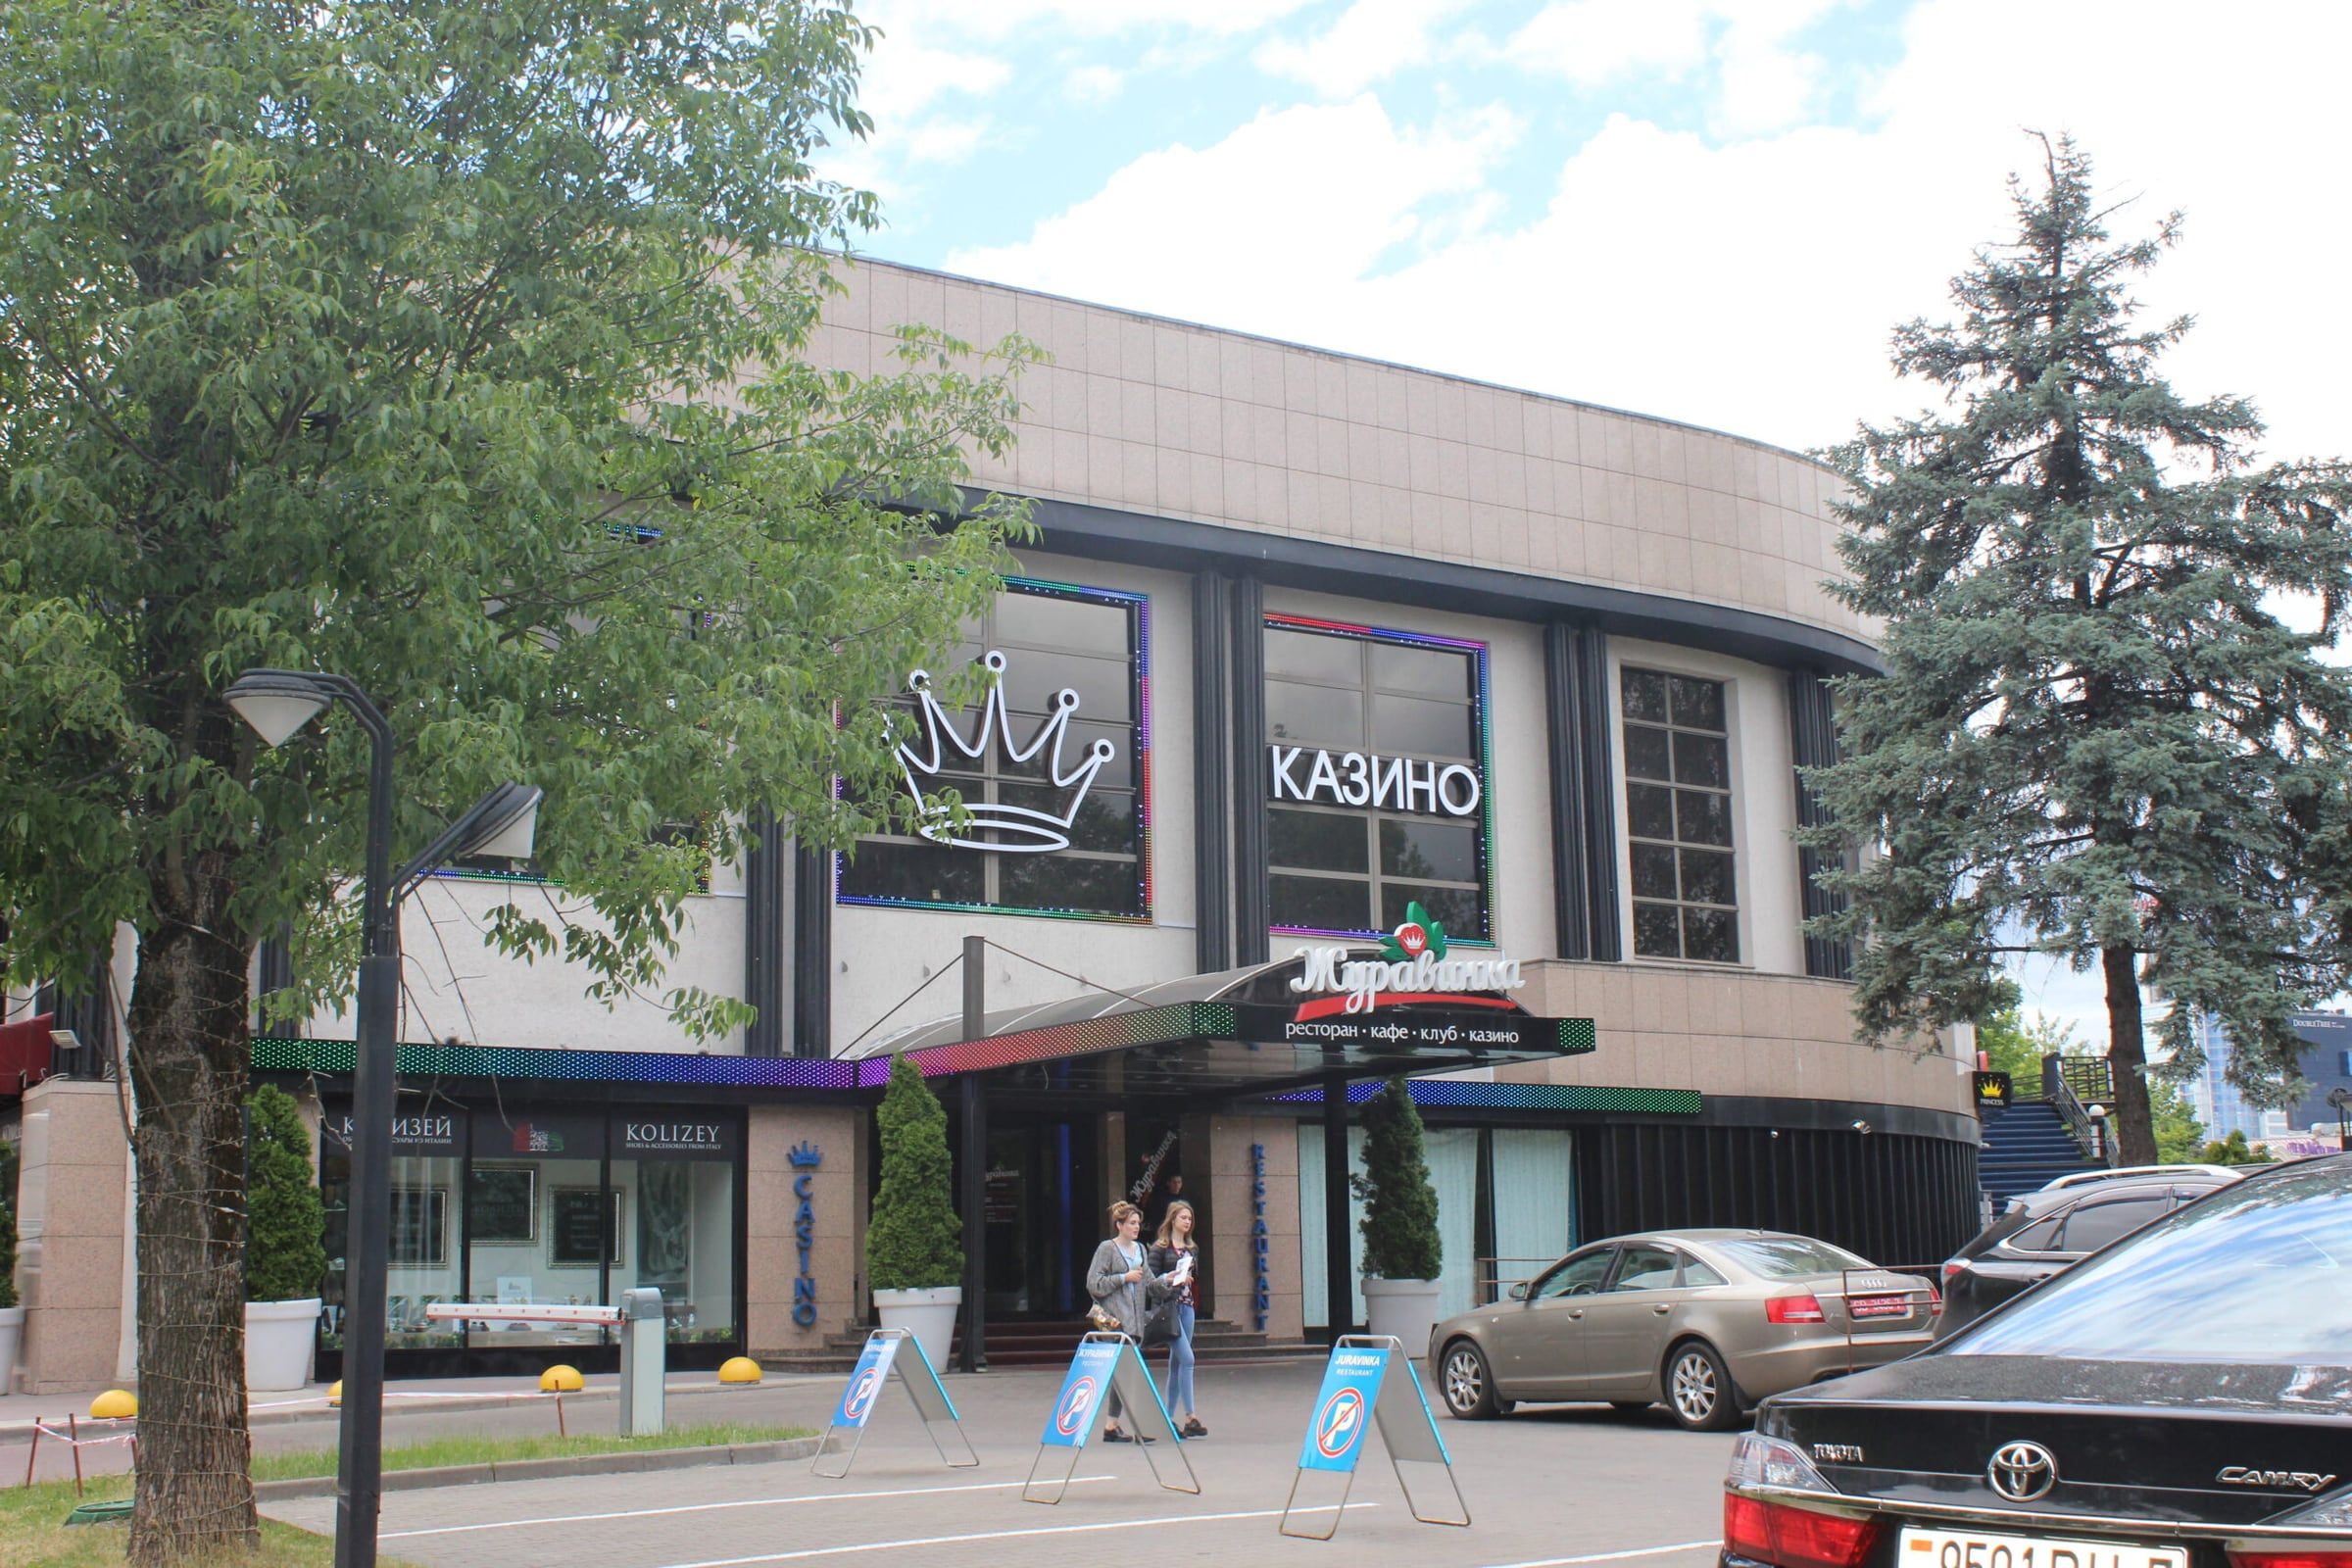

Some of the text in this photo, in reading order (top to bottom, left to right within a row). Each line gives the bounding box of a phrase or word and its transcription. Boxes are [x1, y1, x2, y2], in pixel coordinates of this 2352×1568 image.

[1272, 745, 1480, 816] КАЗИНО
[1290, 946, 1526, 1014] Журавинка
[1286, 1022, 1519, 1044] ресторан кафе клуб казино
[343, 1115, 452, 1137] КИЗЕЙ
[626, 1123, 720, 1143] KOLIZEY
[1251, 1144, 1270, 1331] RESTAURANT
[793, 1175, 817, 1327] CASINO
[1335, 1354, 1381, 1366] JURAVINKA
[1813, 1443, 1863, 1462] TOYOTA
[2216, 1466, 2337, 1491] CAMRY
